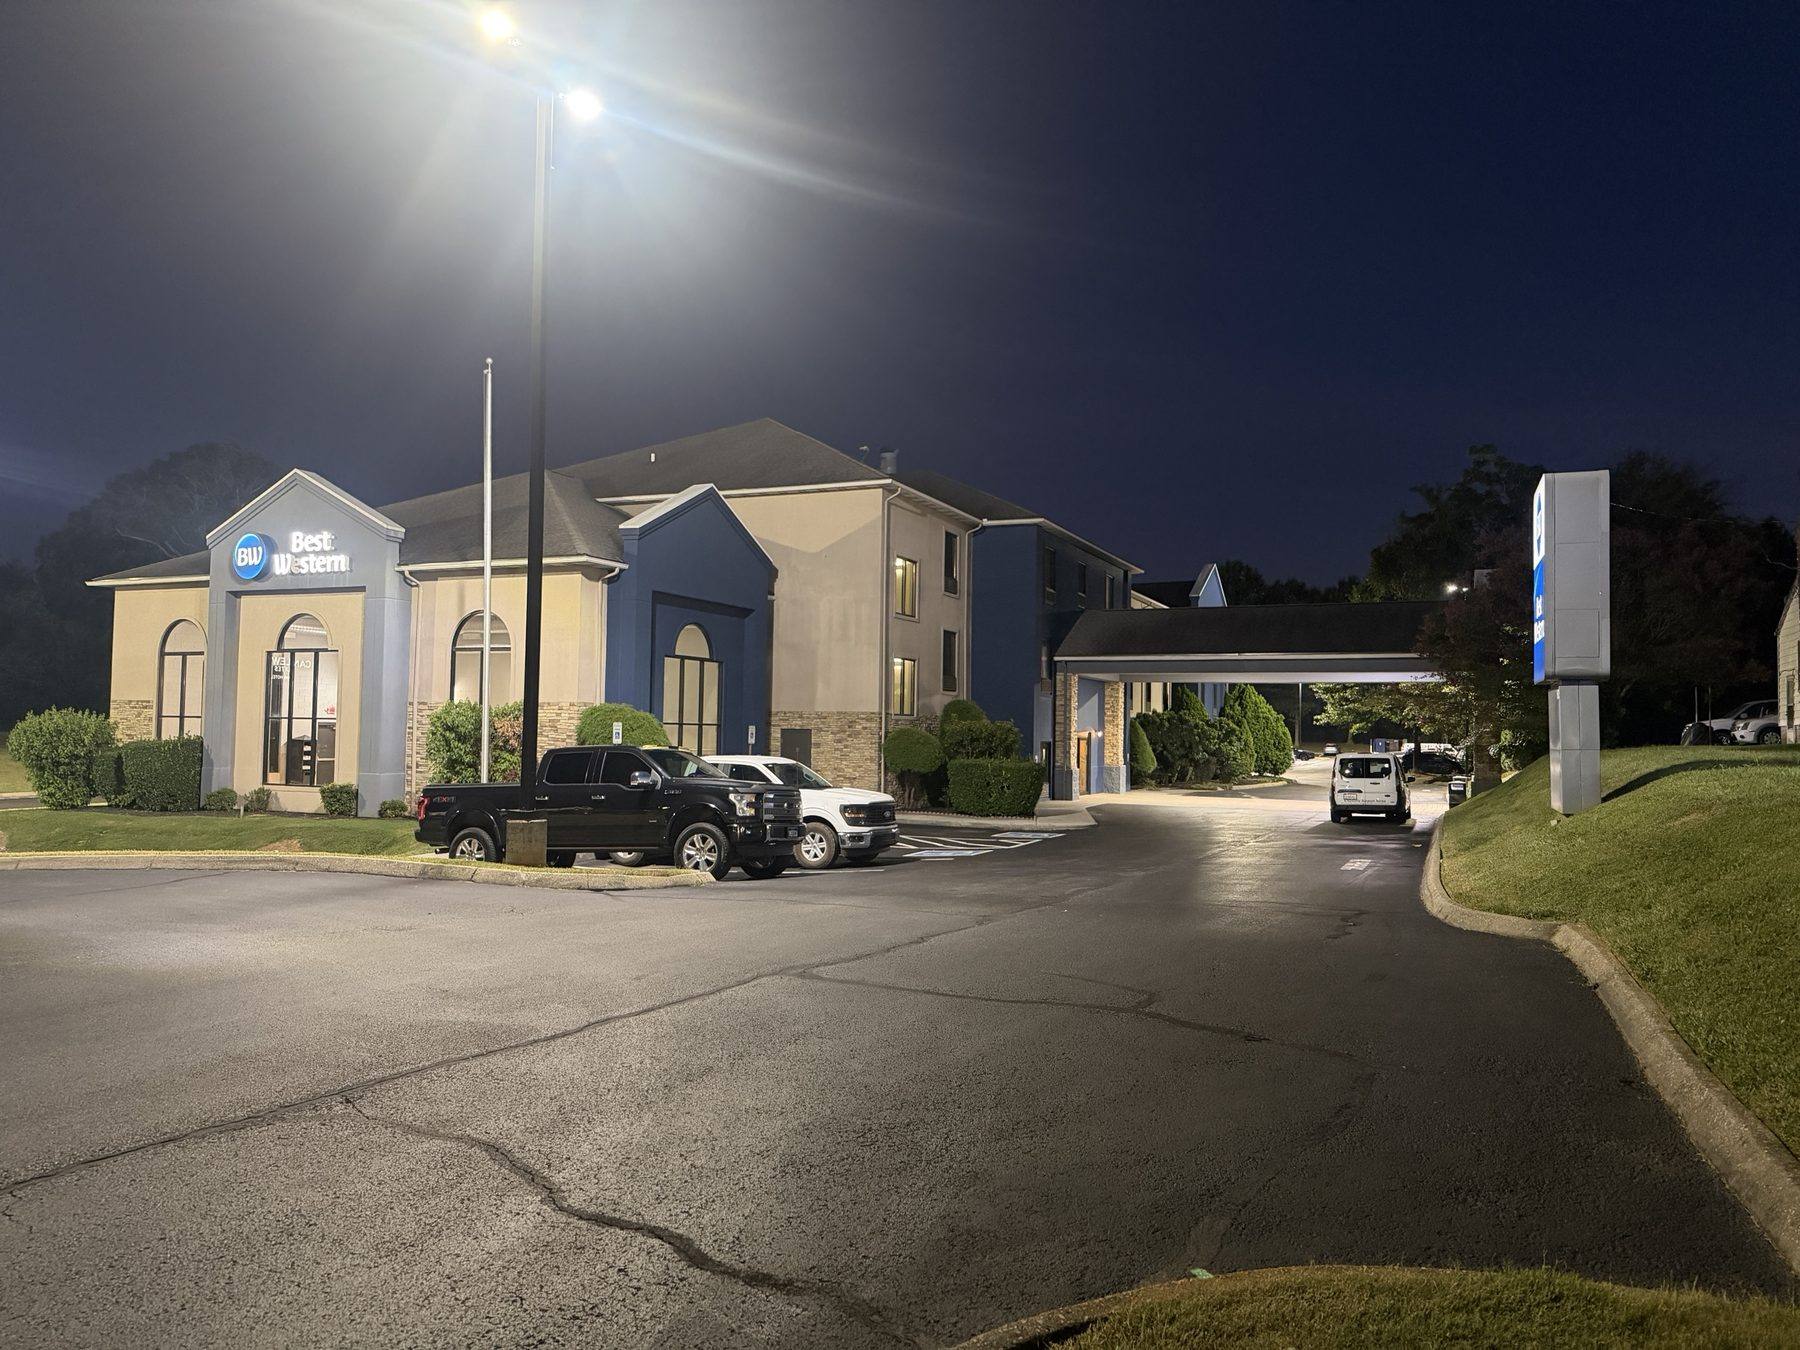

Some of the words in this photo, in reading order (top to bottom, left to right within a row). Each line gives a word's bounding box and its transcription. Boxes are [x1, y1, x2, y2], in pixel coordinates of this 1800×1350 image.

[291, 531, 334, 553] Best
[237, 547, 262, 567] BW
[273, 554, 349, 575] Western
